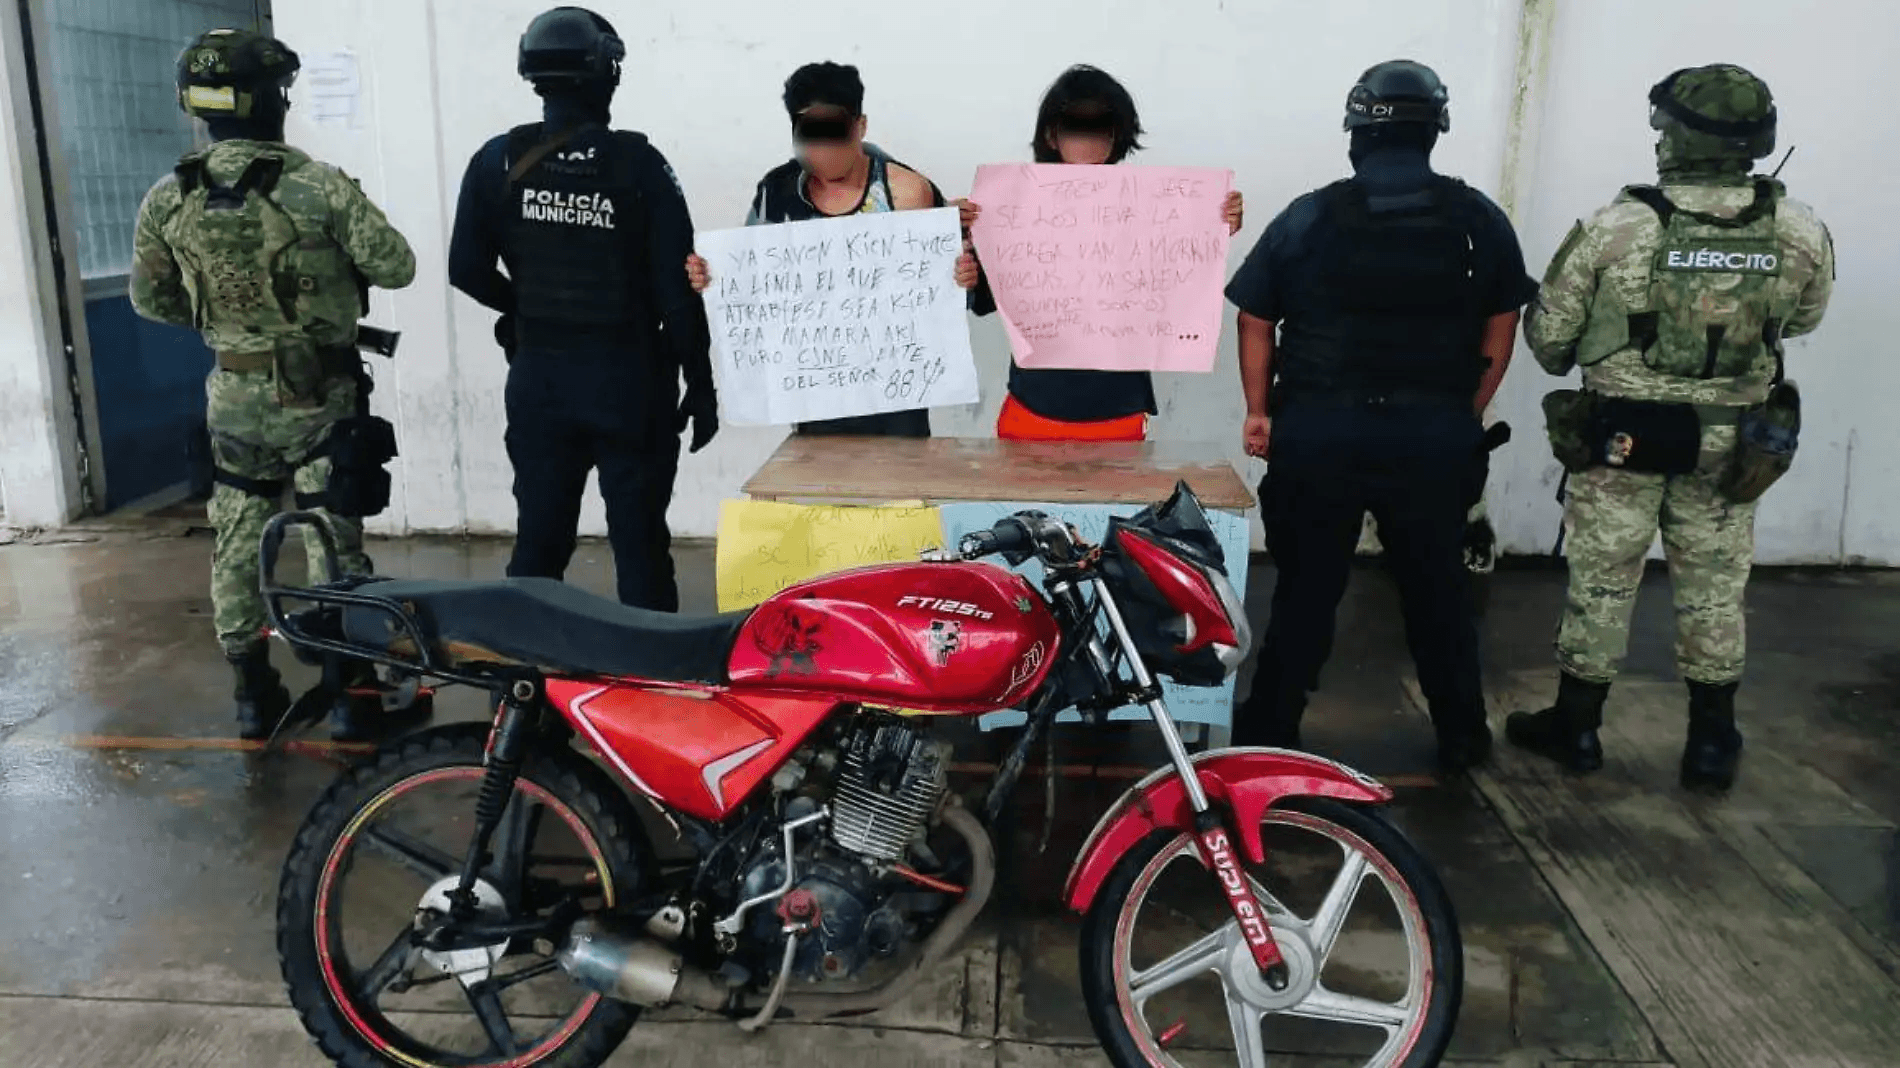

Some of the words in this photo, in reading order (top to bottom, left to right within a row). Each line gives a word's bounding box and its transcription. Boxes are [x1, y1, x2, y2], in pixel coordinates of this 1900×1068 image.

[522, 187, 614, 214] POLICÍA
[521, 203, 615, 229] MUNICIPAL
[1152, 204, 1180, 226] LA
[1667, 247, 1778, 271] EJÉRCITO
[727, 325, 764, 347] SEA
[781, 375, 821, 391] DEL
